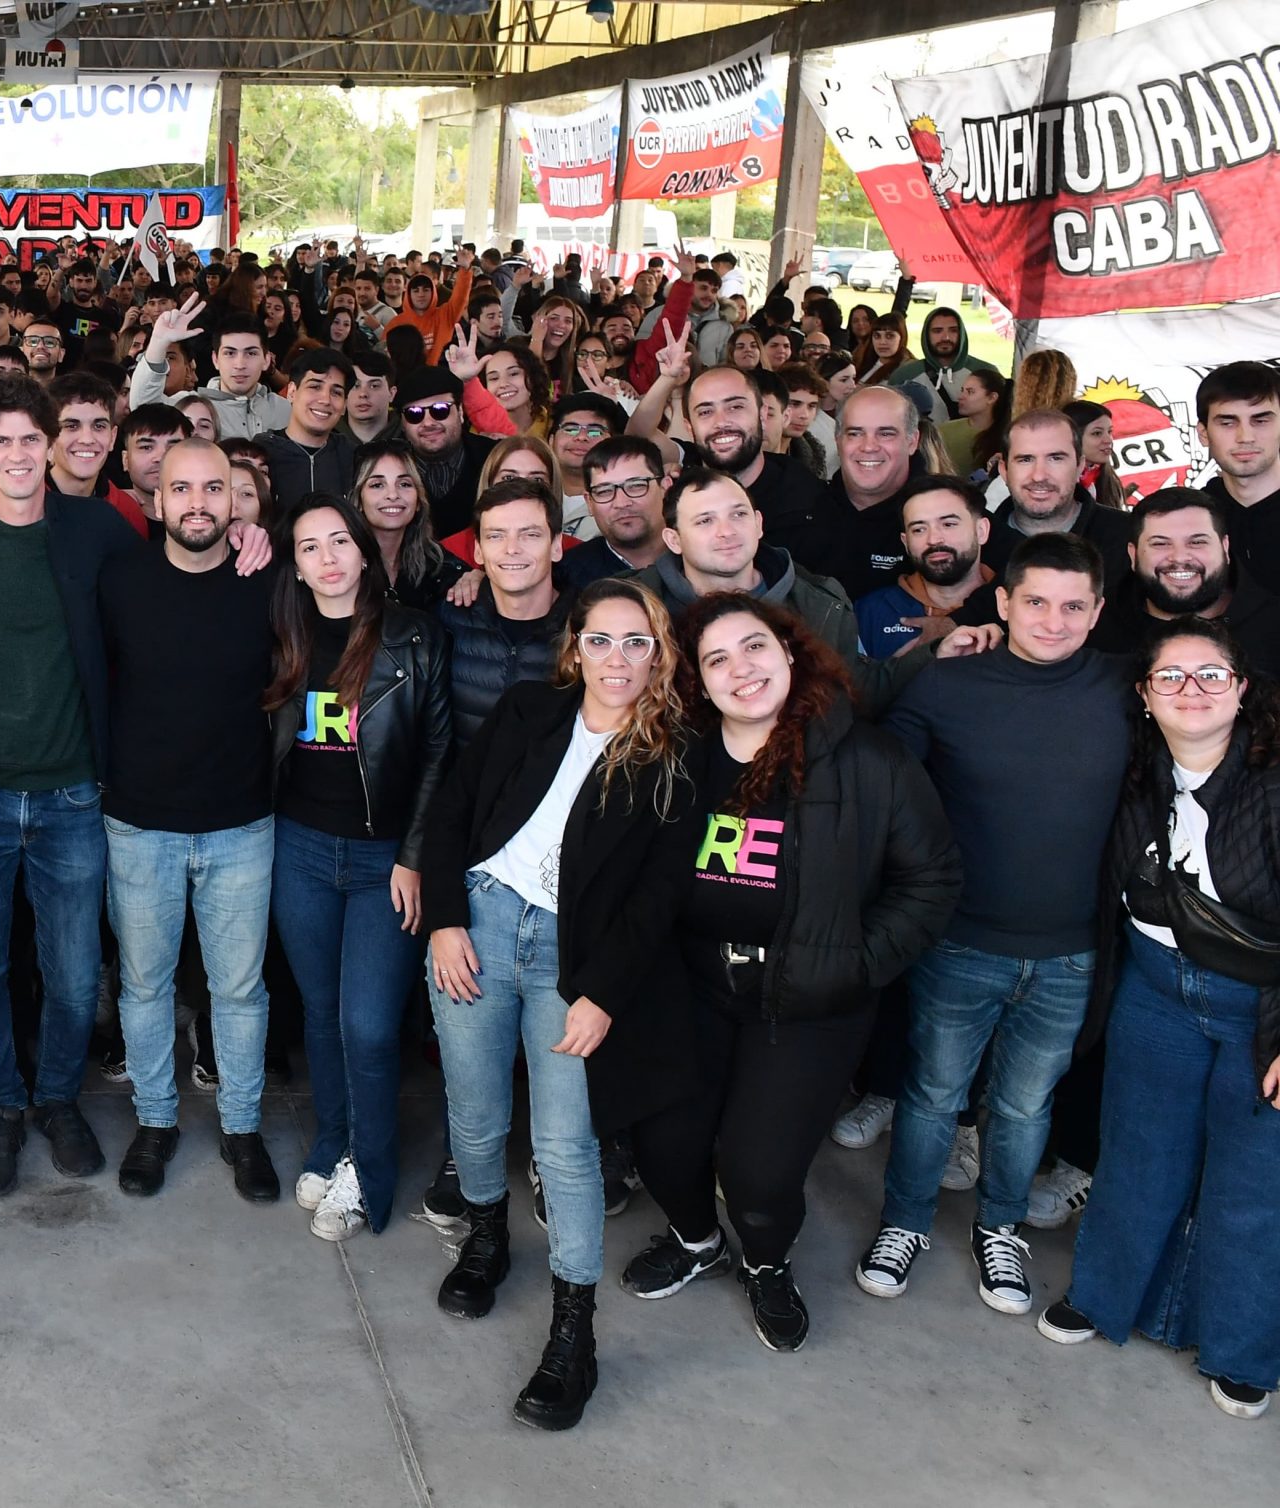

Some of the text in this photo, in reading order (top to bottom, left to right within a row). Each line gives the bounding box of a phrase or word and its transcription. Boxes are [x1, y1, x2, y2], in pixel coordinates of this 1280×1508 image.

[641, 80, 710, 113] JUVENTUD
[639, 136, 661, 150] UCR
[665, 121, 709, 154] BARRIO
[962, 92, 1144, 206] JUVENTUD
[660, 154, 763, 196] COMUNA 8
[150, 227, 170, 252] UCR
[1053, 189, 1225, 277] CABA
[696, 872, 776, 889] RADICAL EVOLUCIÓN
